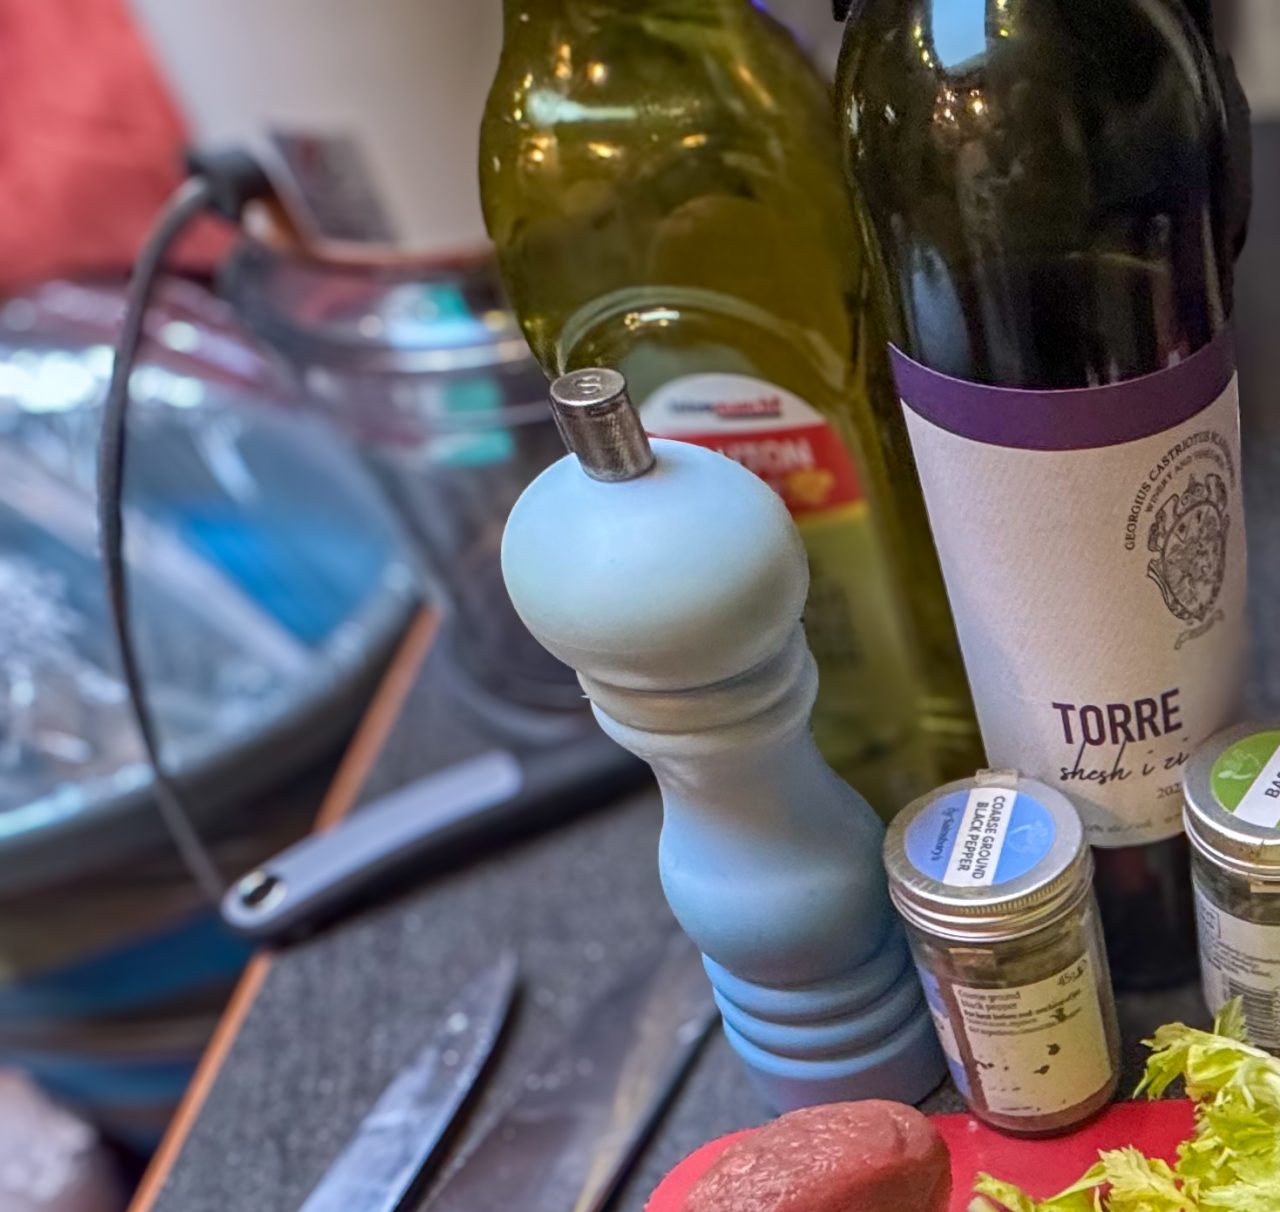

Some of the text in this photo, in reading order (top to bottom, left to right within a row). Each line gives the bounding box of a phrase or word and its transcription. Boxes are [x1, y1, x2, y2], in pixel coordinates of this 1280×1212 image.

[1124, 481, 1151, 551] GEORGIUS
[1051, 688, 1183, 746] TORRE
[1059, 738, 1132, 786] shesh
[1142, 749, 1156, 776] i
[957, 801, 990, 872] BLACK PEPPER
[972, 795, 1006, 880] COARSE GROUND
